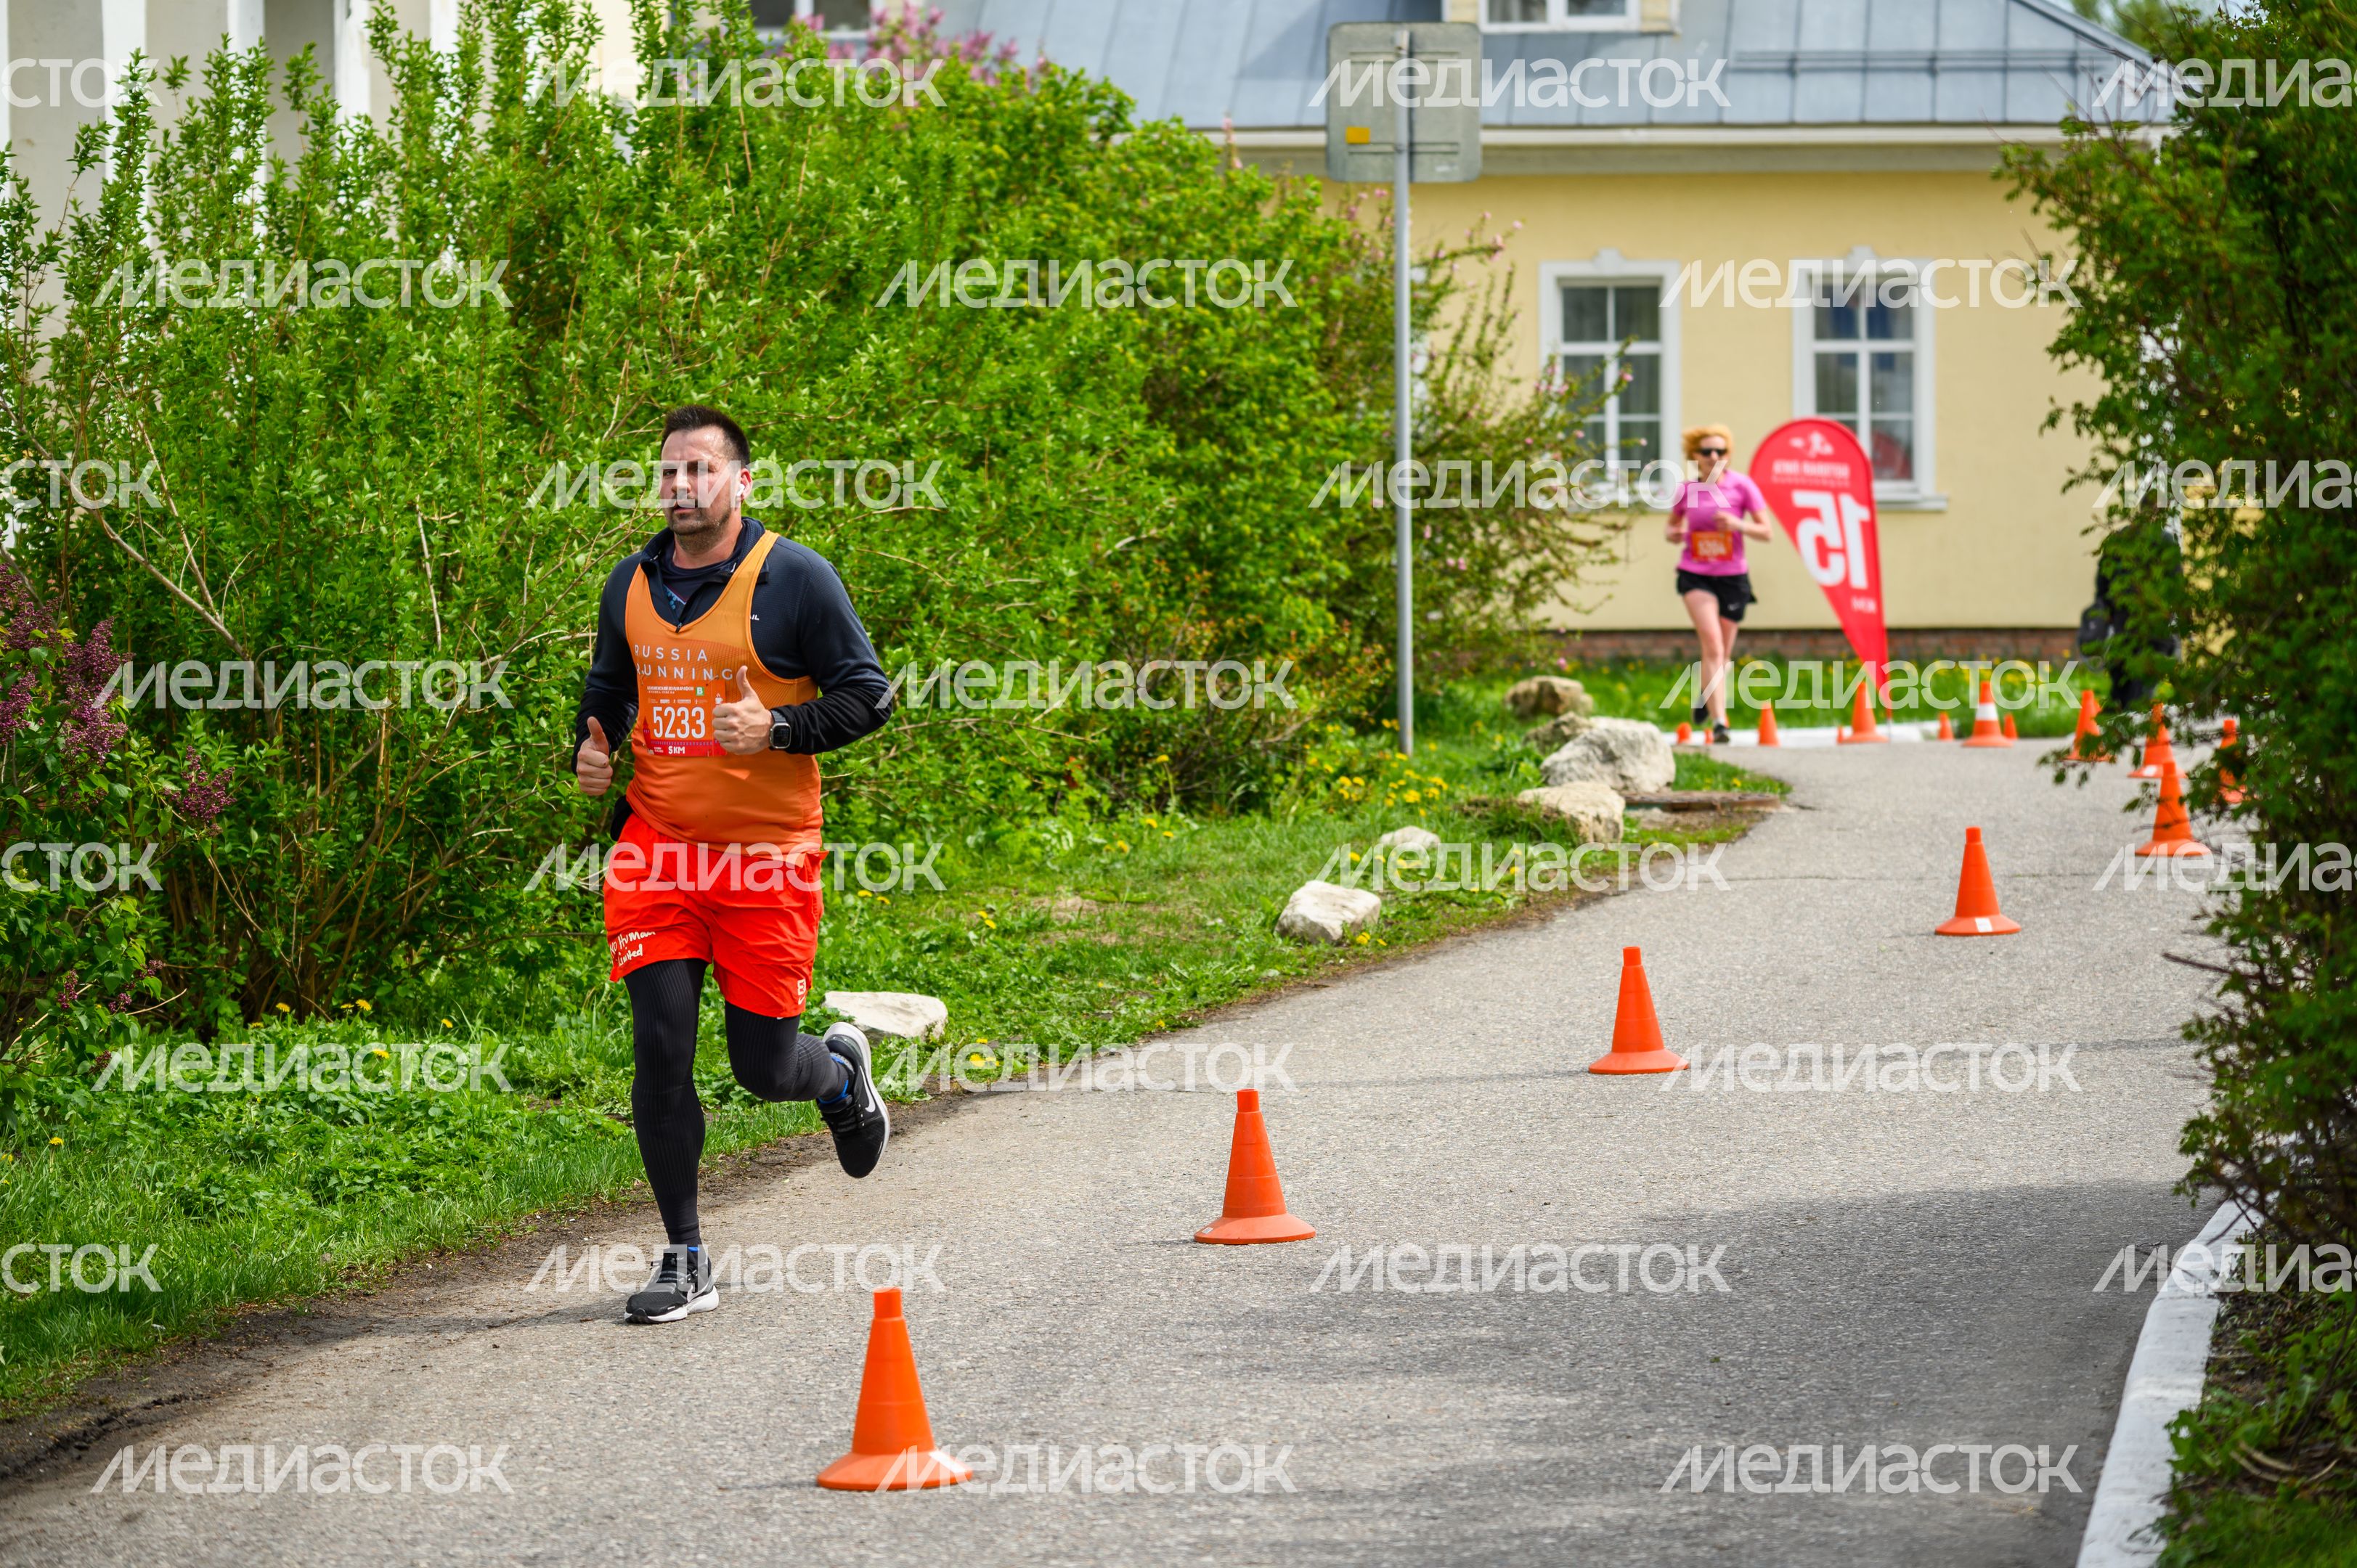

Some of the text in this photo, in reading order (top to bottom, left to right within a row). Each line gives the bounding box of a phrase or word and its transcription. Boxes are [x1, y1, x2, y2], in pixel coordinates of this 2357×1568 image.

[635, 644, 707, 662] RUSSIA
[637, 663, 733, 680] RUNNING
[653, 706, 706, 739] 5233
